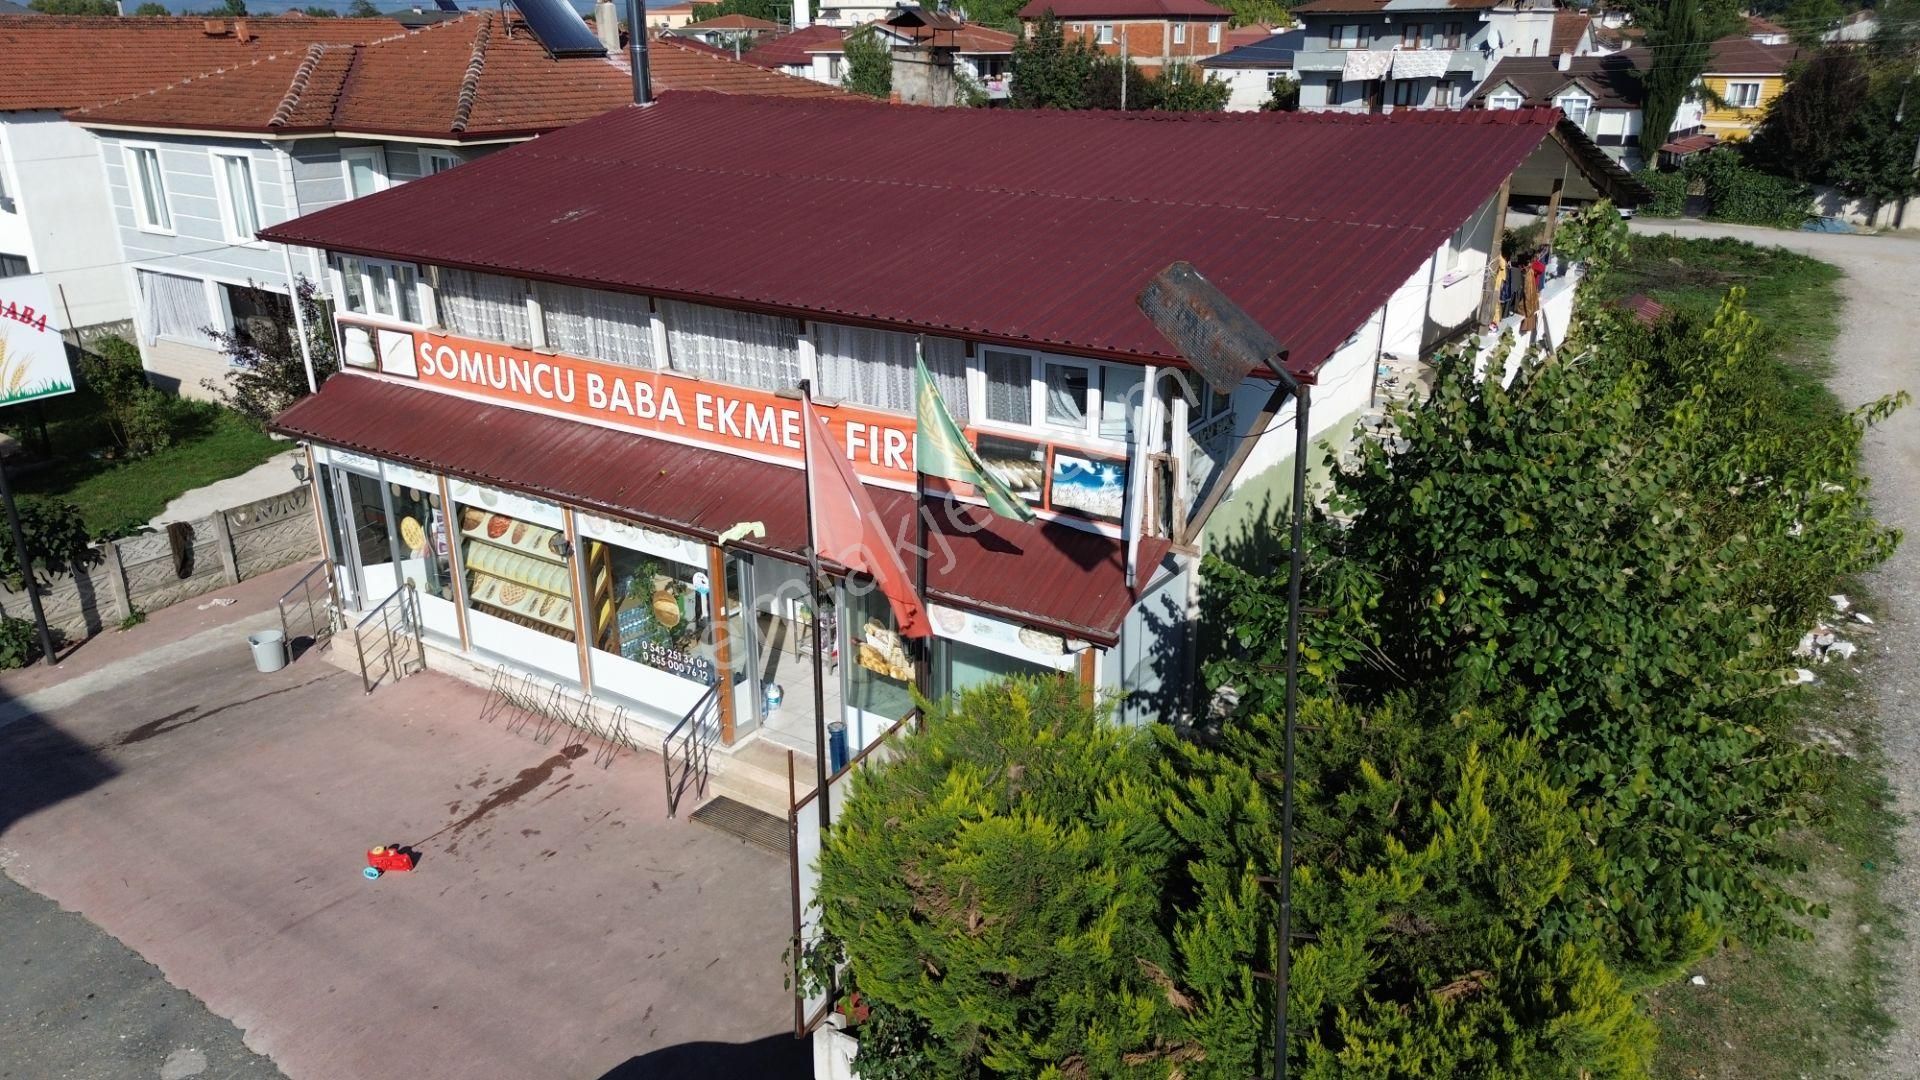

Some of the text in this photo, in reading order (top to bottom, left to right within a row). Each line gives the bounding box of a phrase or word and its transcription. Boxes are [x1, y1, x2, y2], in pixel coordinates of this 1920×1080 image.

[0, 299, 47, 332] ABA
[420, 341, 575, 403] SOMUNCU
[586, 372, 686, 426] BABA
[695, 392, 829, 450] EKME
[641, 640, 648, 650] 0
[649, 643, 666, 656] 543
[667, 649, 682, 661] 251
[683, 654, 694, 666] 34
[642, 651, 709, 681] 0 555 000 76 12
